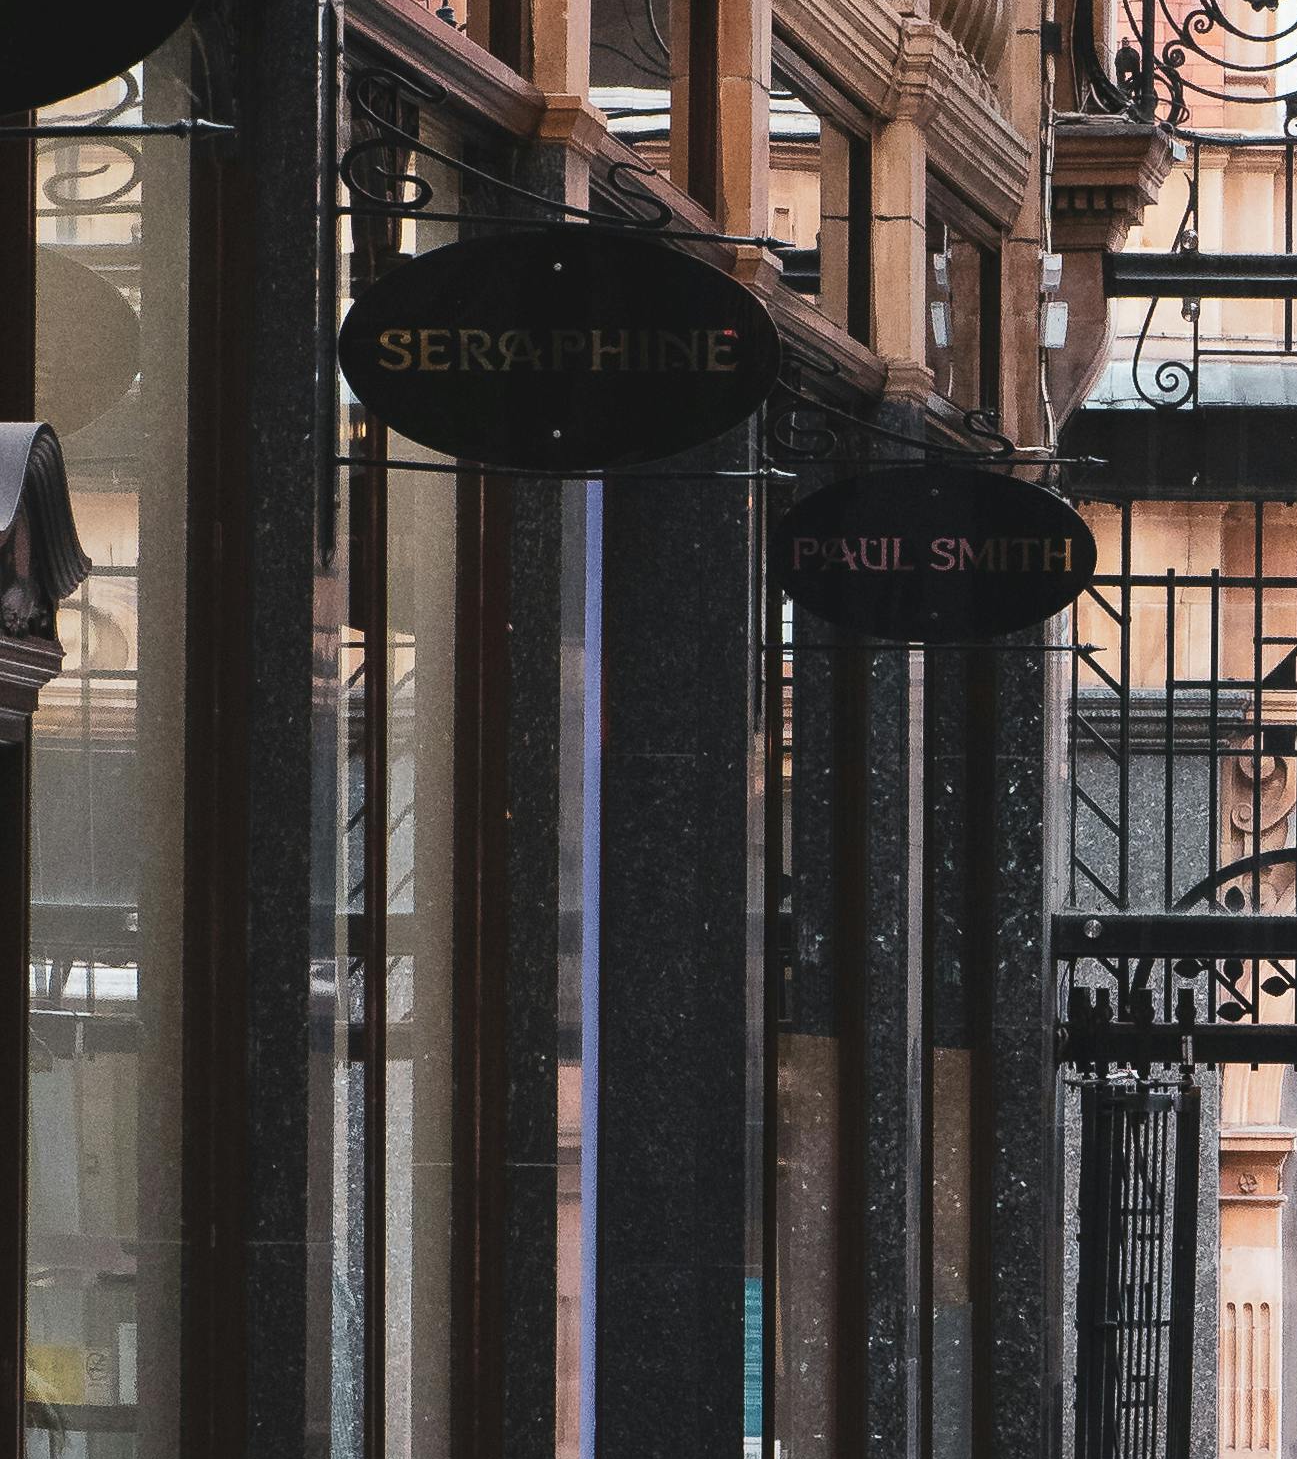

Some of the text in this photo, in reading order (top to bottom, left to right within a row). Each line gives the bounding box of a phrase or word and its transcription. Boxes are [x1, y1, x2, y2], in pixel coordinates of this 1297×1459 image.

[379, 328, 739, 372] SERAPHINE
[792, 537, 1072, 572] PAUL SMITH
